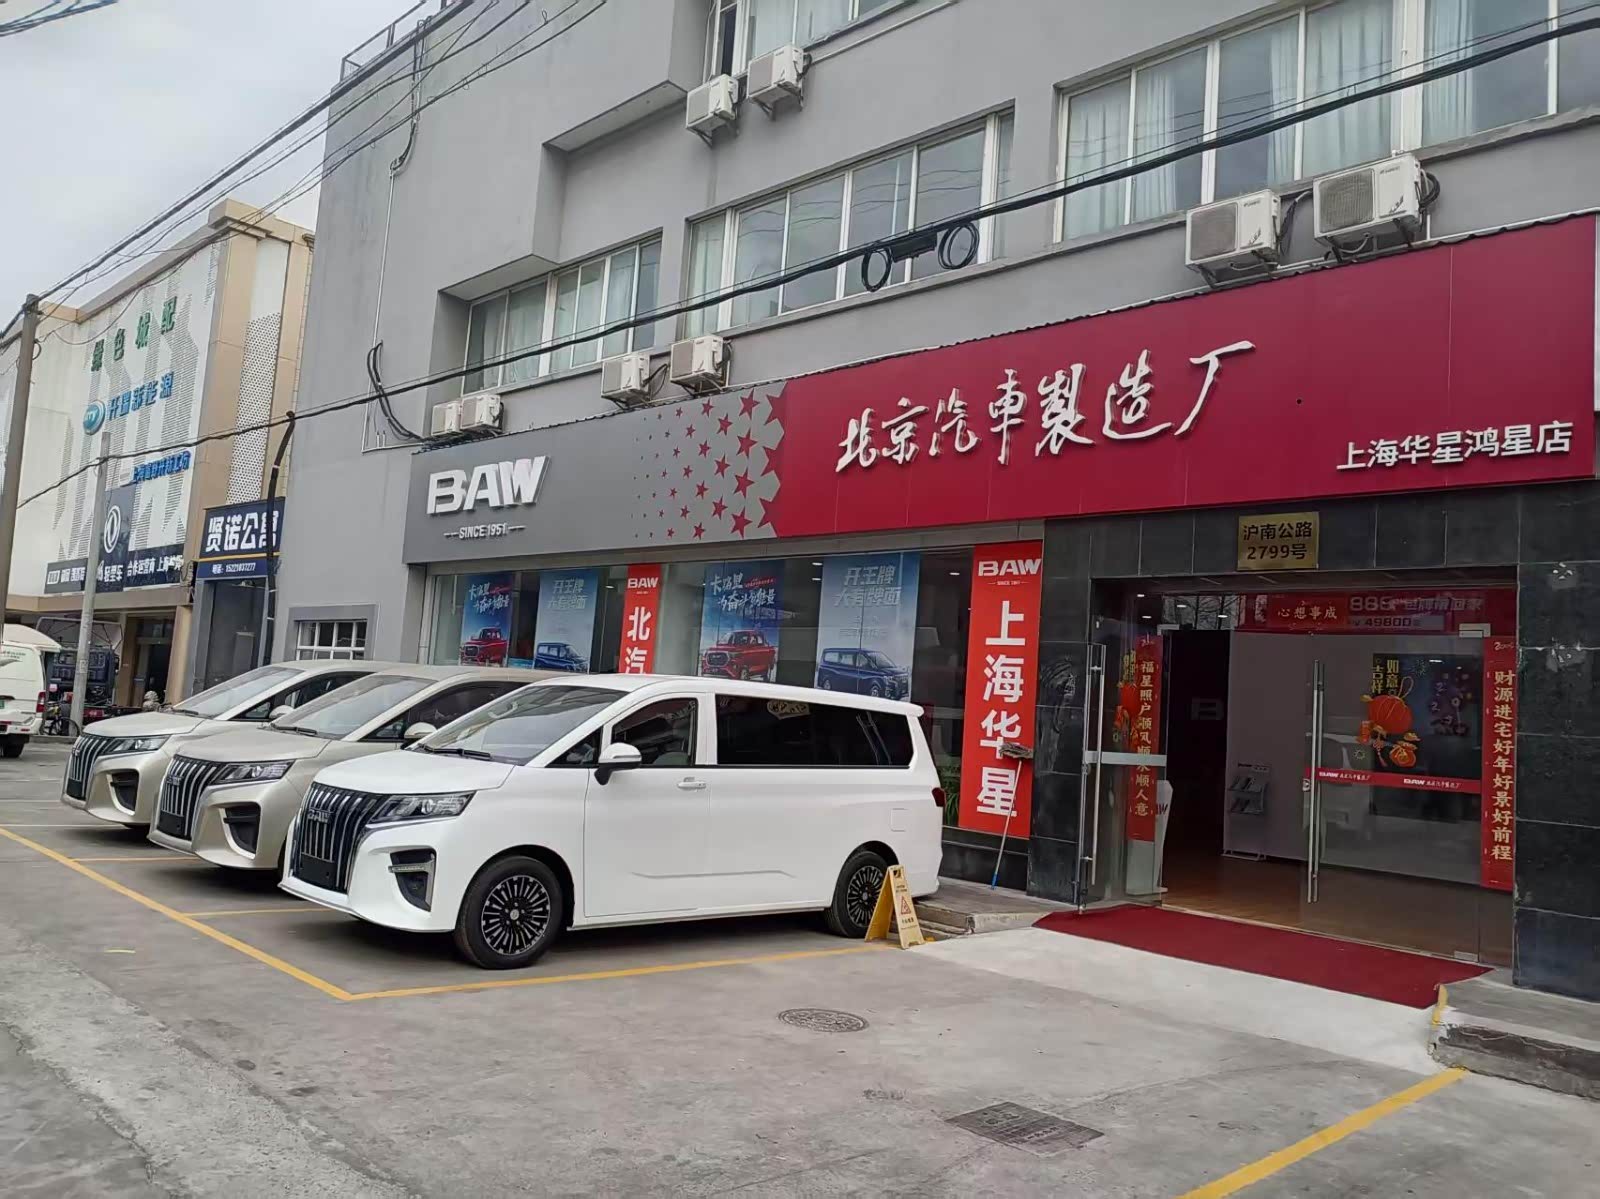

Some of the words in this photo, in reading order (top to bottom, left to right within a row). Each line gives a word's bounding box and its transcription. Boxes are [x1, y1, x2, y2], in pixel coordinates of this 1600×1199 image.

[1336, 421, 1574, 472] 上海华星鸿星店
[426, 455, 550, 515] BAW
[458, 524, 486, 540] SINCE
[486, 522, 508, 537] 1951
[1243, 521, 1312, 540] 沪南公路
[1247, 543, 1307, 560] 2799号
[978, 558, 1042, 577] BAW
[627, 577, 659, 589] BAW
[1277, 604, 1338, 620] 心想事成
[976, 600, 1026, 817] 上海华星
[1491, 670, 1516, 861] 财源进宅好年好景好前程
